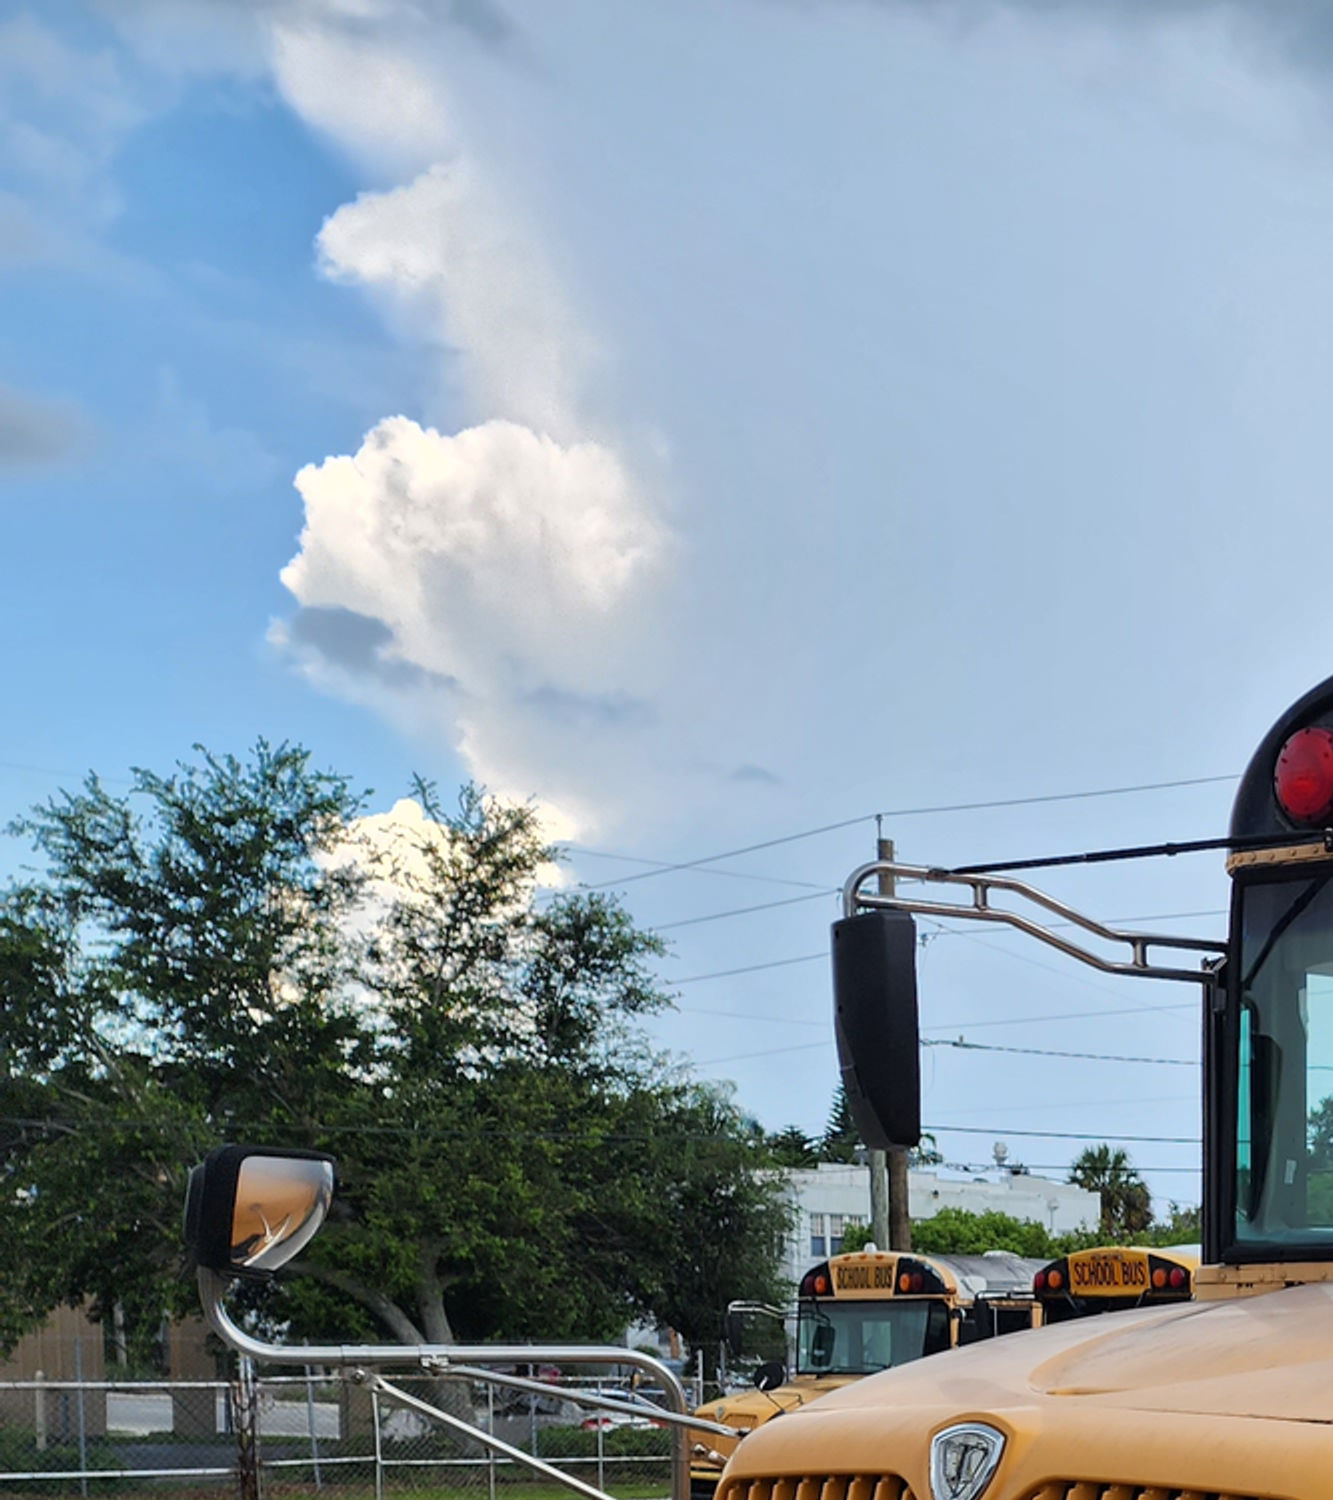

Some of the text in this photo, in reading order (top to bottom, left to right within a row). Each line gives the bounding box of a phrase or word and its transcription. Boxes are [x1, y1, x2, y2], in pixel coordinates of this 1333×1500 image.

[837, 1266, 893, 1289] SCHOOL BUS
[1073, 1261, 1146, 1286] SCHOOL BUS
